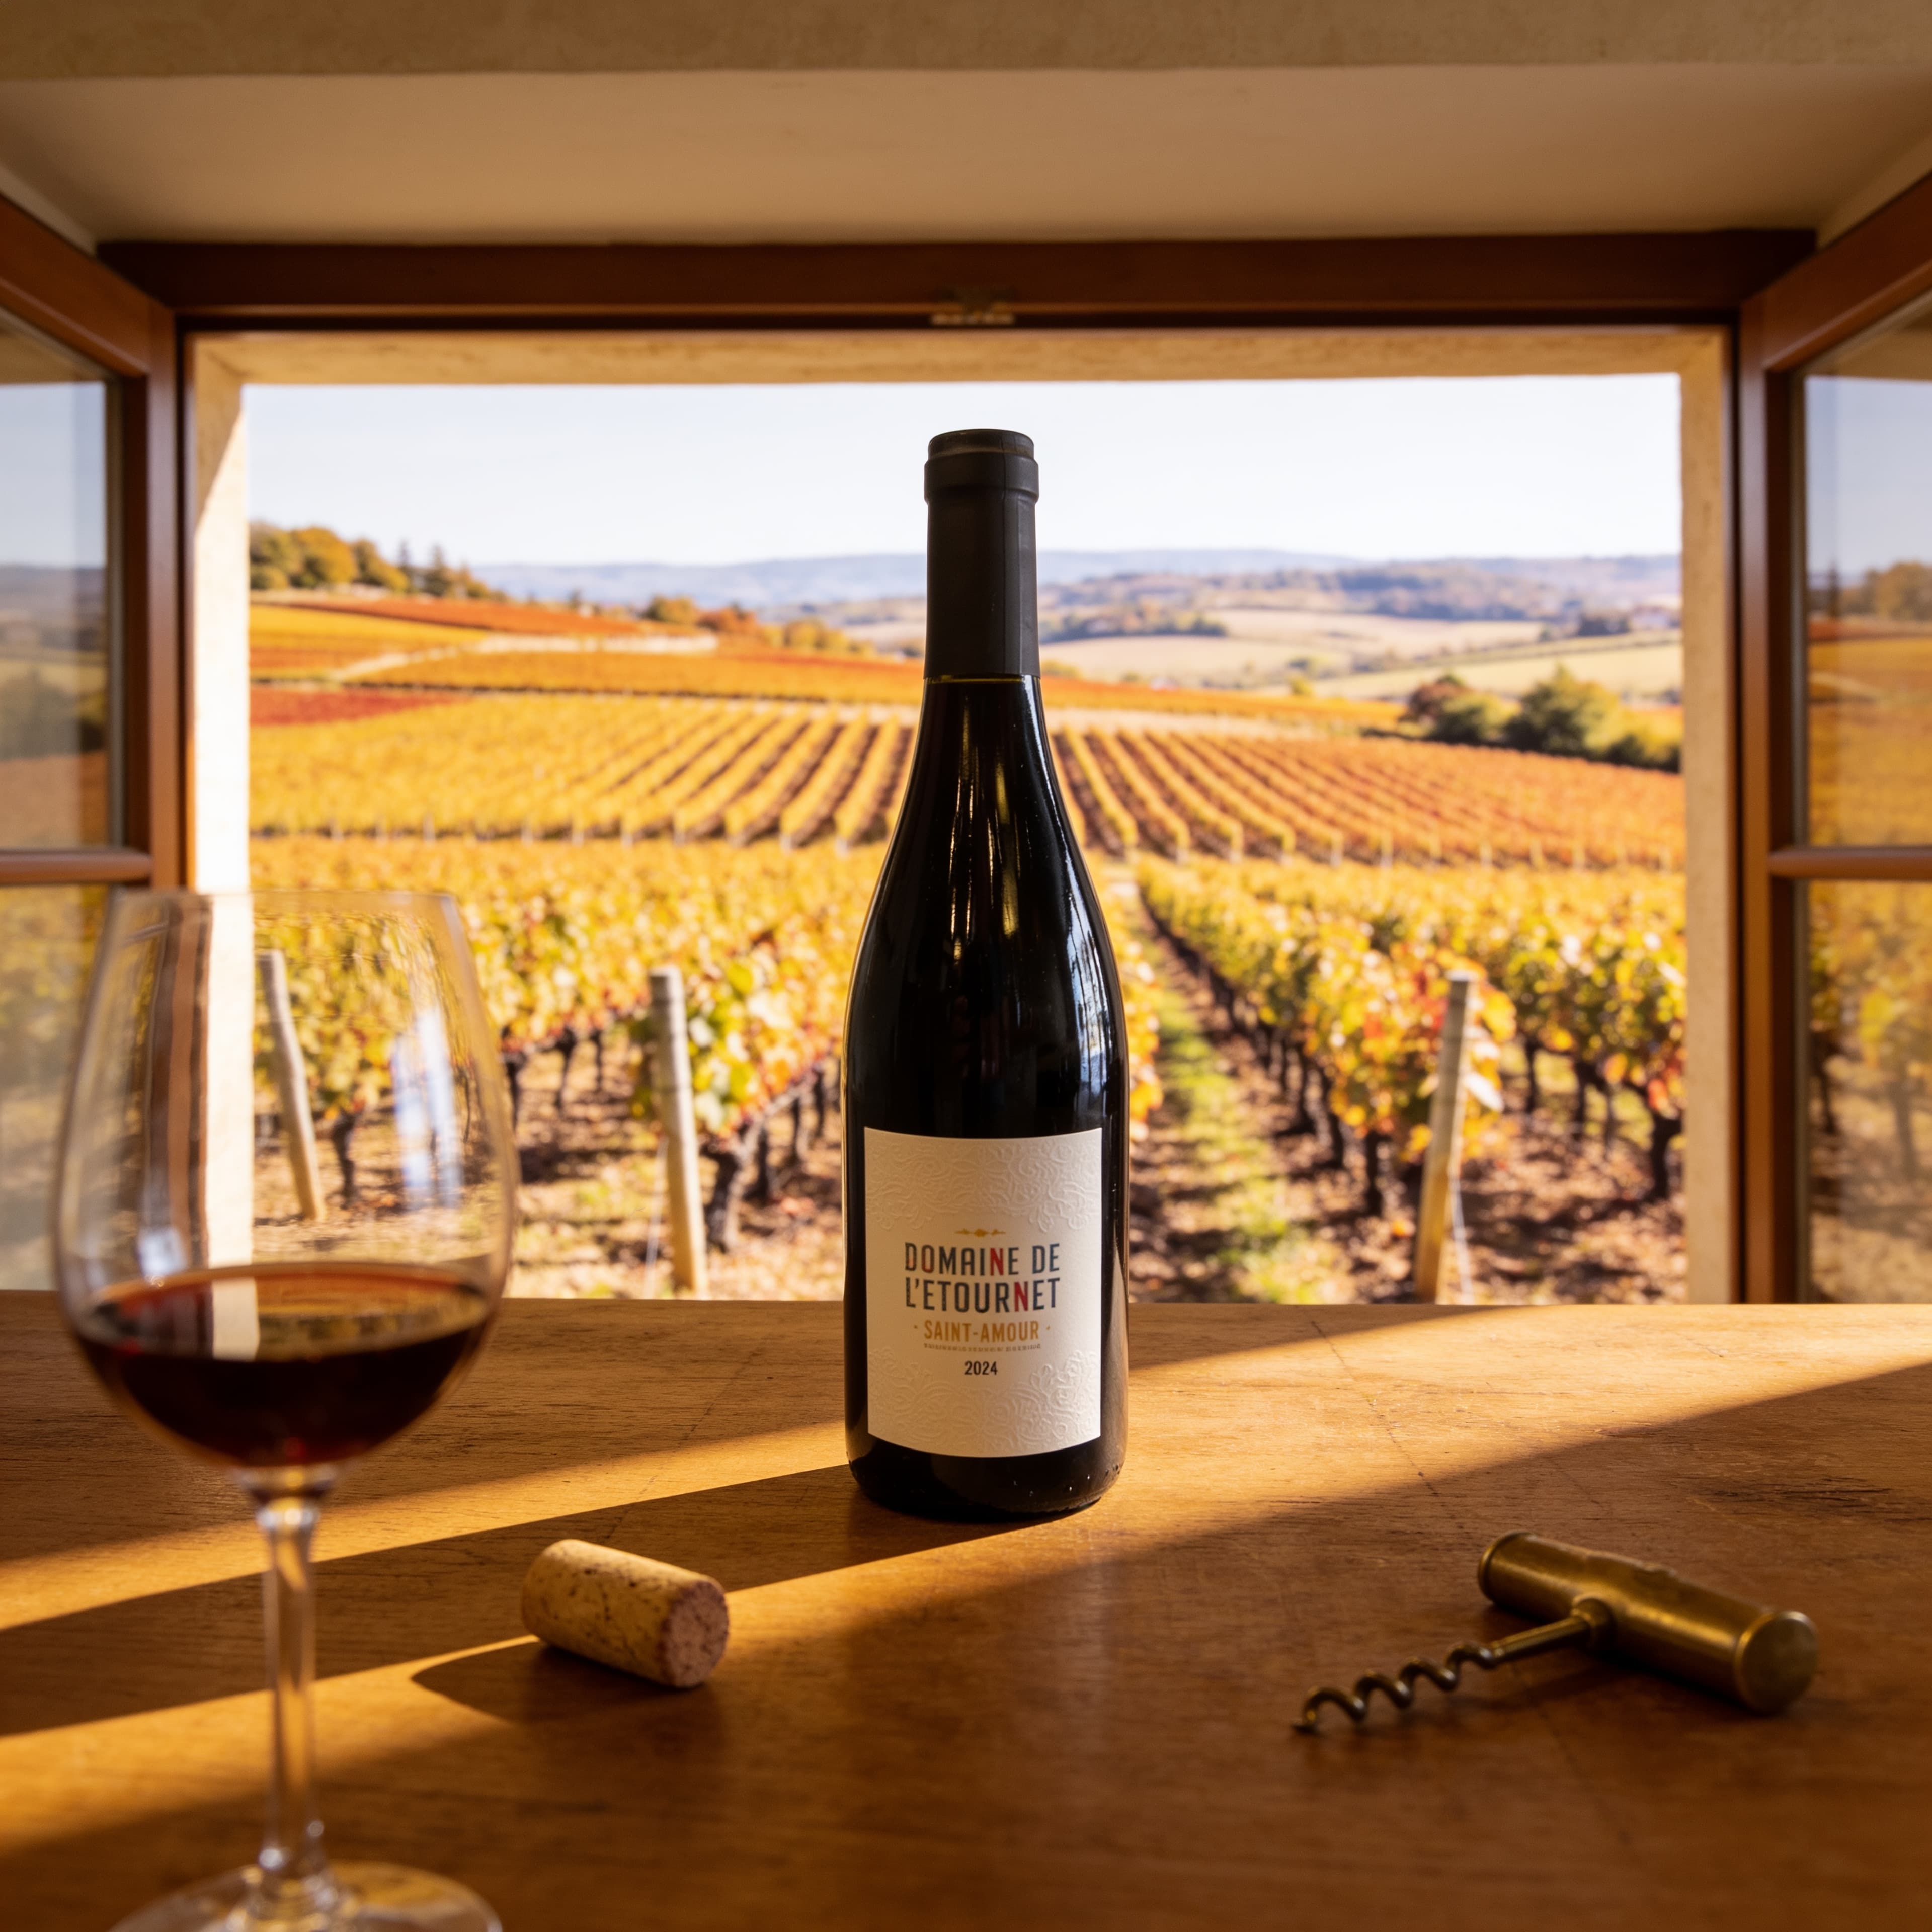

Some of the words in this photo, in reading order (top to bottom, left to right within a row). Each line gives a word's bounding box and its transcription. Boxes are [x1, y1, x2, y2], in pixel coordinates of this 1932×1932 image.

[905, 1242, 1019, 1276] DOMAINE
[1032, 1243, 1060, 1274] DE
[905, 1277, 1061, 1314] L'ETOURNET
[924, 1320, 1039, 1343] SAINT-AMOUR
[964, 1361, 998, 1376] 2024
